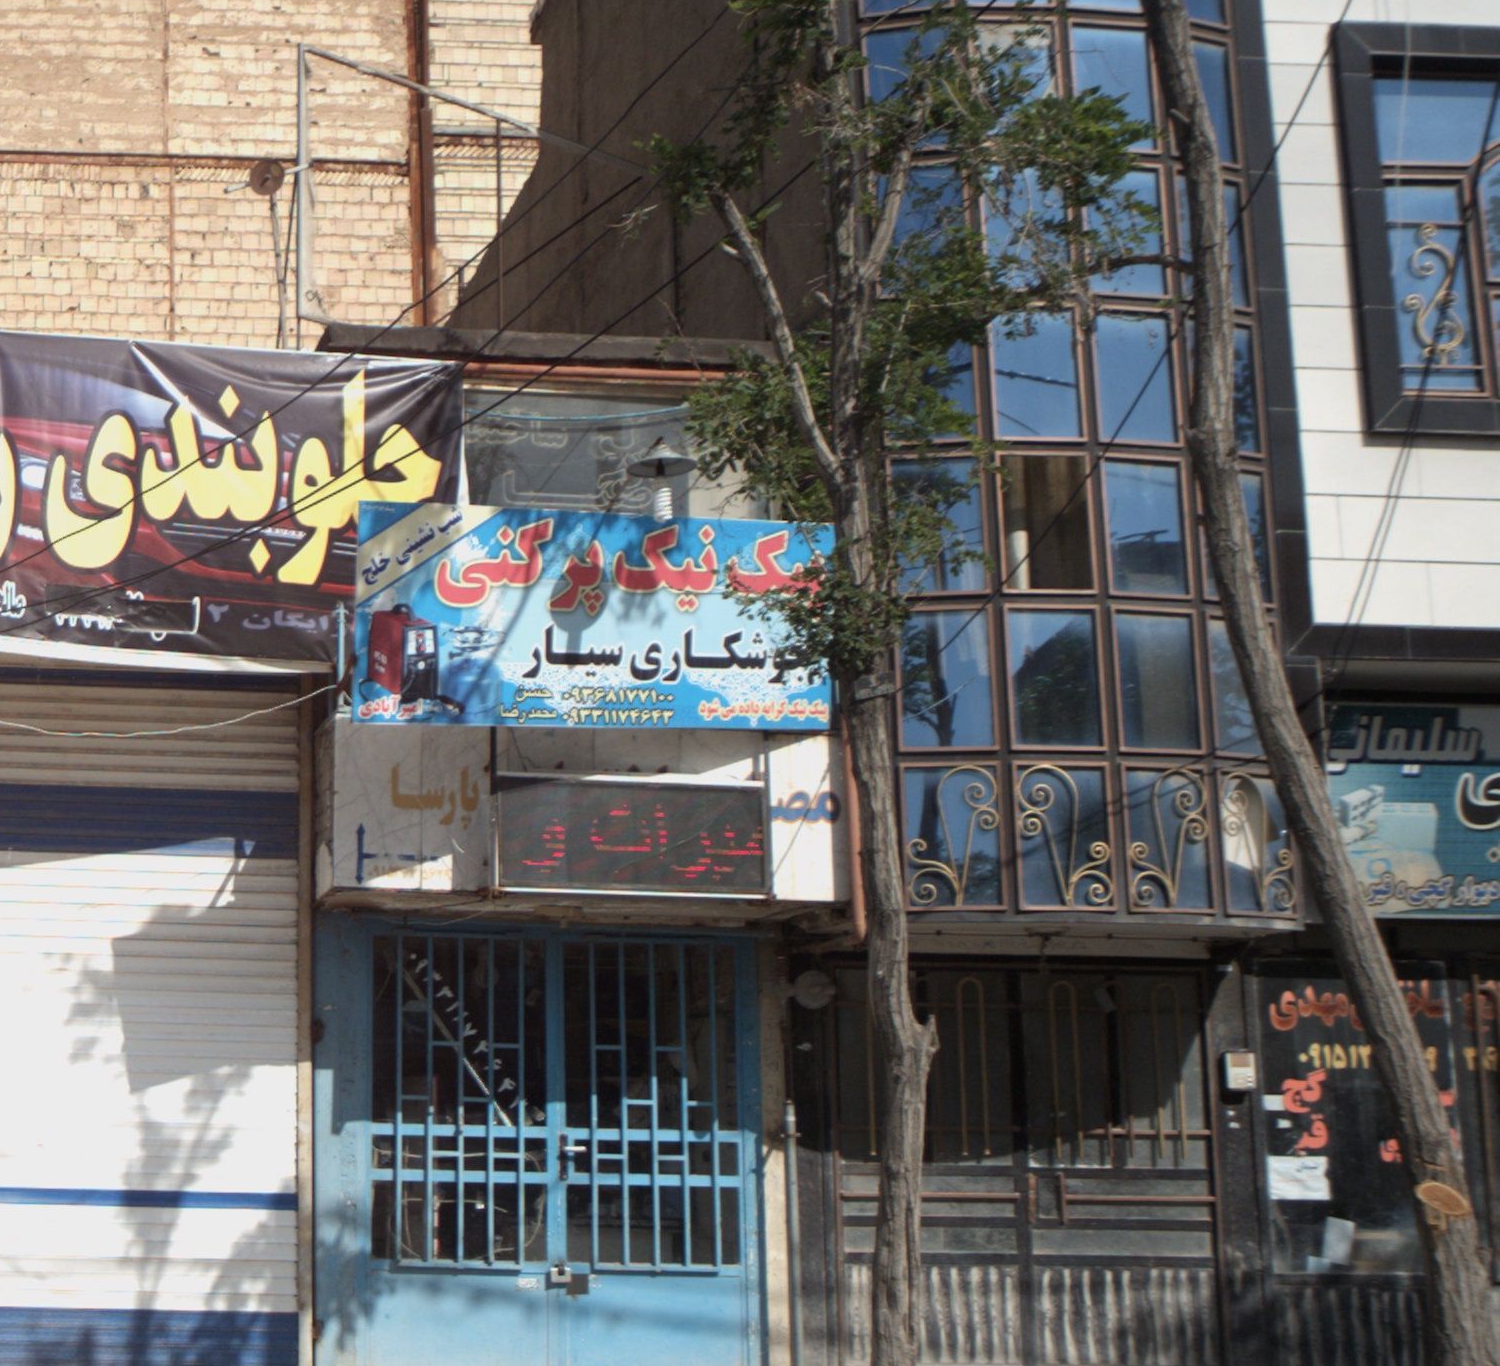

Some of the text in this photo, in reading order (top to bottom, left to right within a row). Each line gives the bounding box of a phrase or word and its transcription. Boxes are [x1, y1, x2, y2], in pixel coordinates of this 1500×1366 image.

[46, 369, 442, 586] جلوبندی
[613, 523, 717, 613] نیک
[521, 624, 812, 685] جوشکاری سیار
[515, 685, 674, 704] ۰۹۳۶۸۱۷۷۱۰۰ حسن
[390, 762, 480, 831] پارسا
